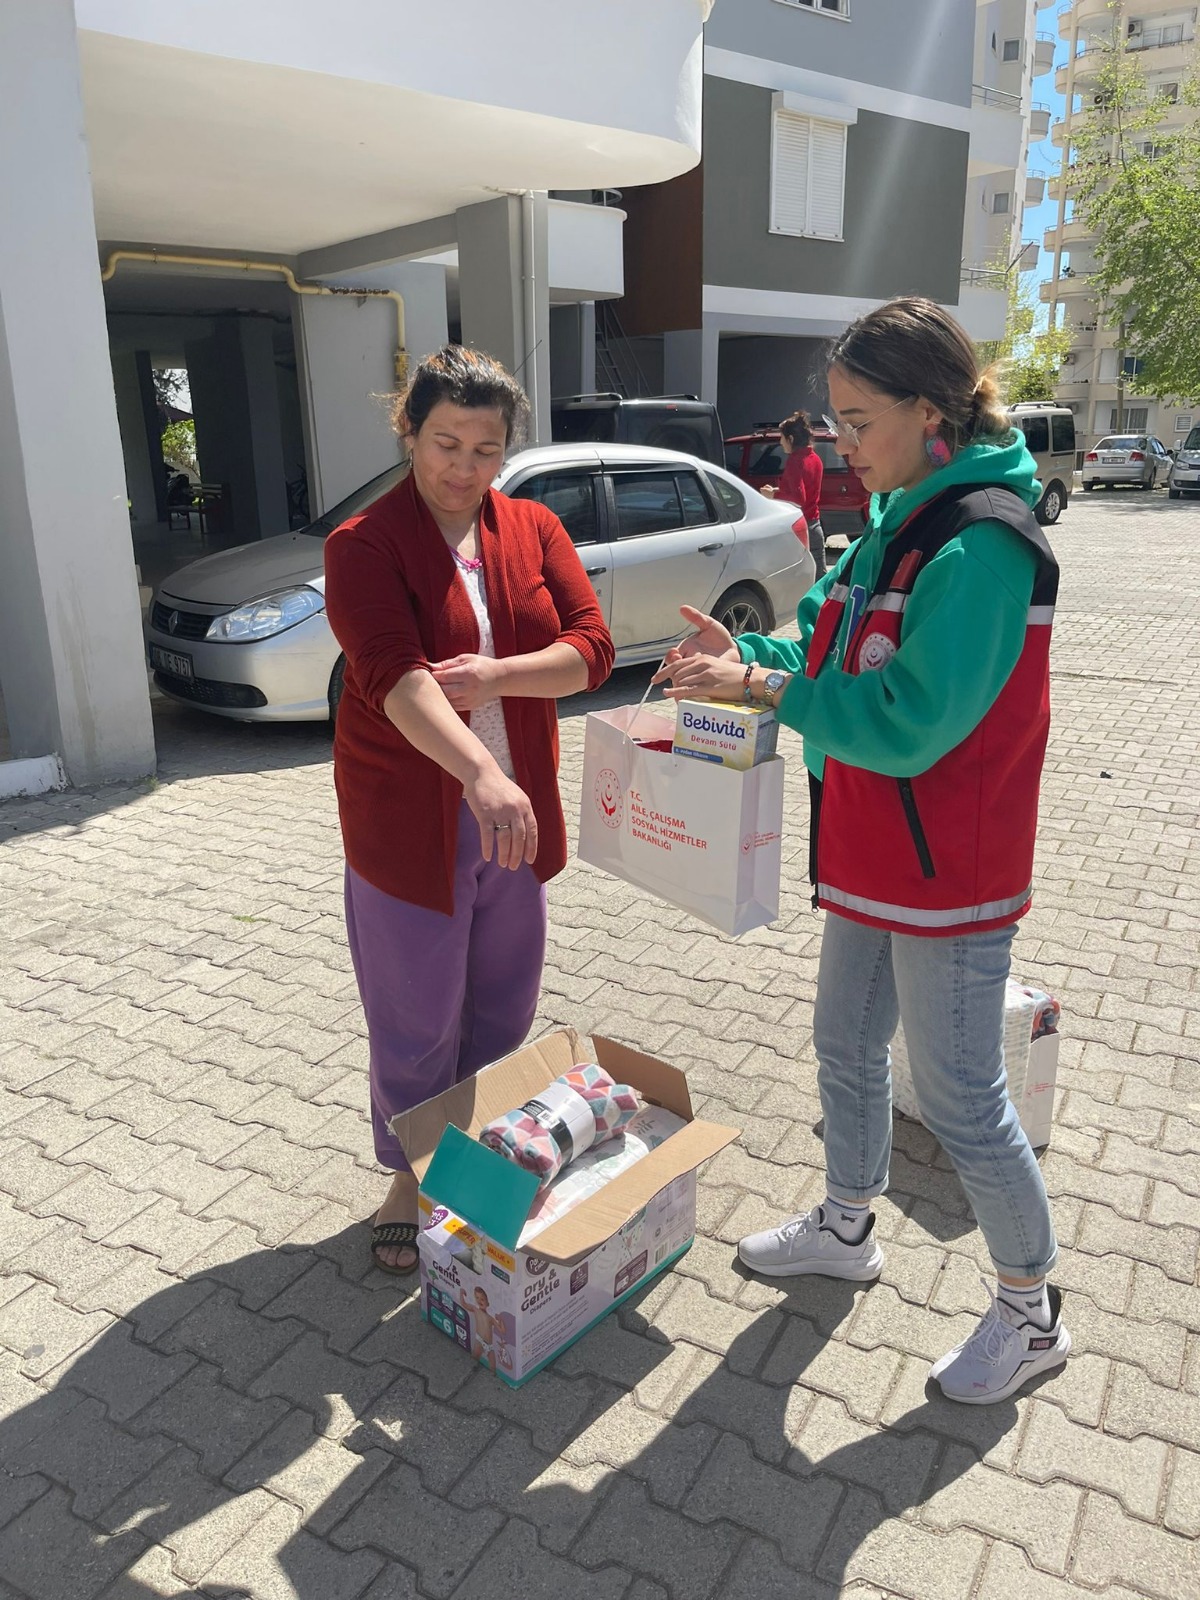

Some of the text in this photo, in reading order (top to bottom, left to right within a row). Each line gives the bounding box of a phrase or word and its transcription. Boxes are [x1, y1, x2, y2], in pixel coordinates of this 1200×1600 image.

[683, 712, 746, 739] Bebivita
[690, 734, 737, 751] Devam Sütü
[630, 790, 643, 802] T.C.
[631, 816, 707, 850] SOSYAL HİZMETLER
[649, 811, 686, 830] ÇALIŞMA
[632, 828, 672, 852] BAKANLIĞI
[432, 1260, 461, 1287] Gentle
[524, 1276, 546, 1299] Dry
[548, 1268, 557, 1281] &
[520, 1278, 561, 1312] Gentle
[442, 1318, 453, 1335] 6
